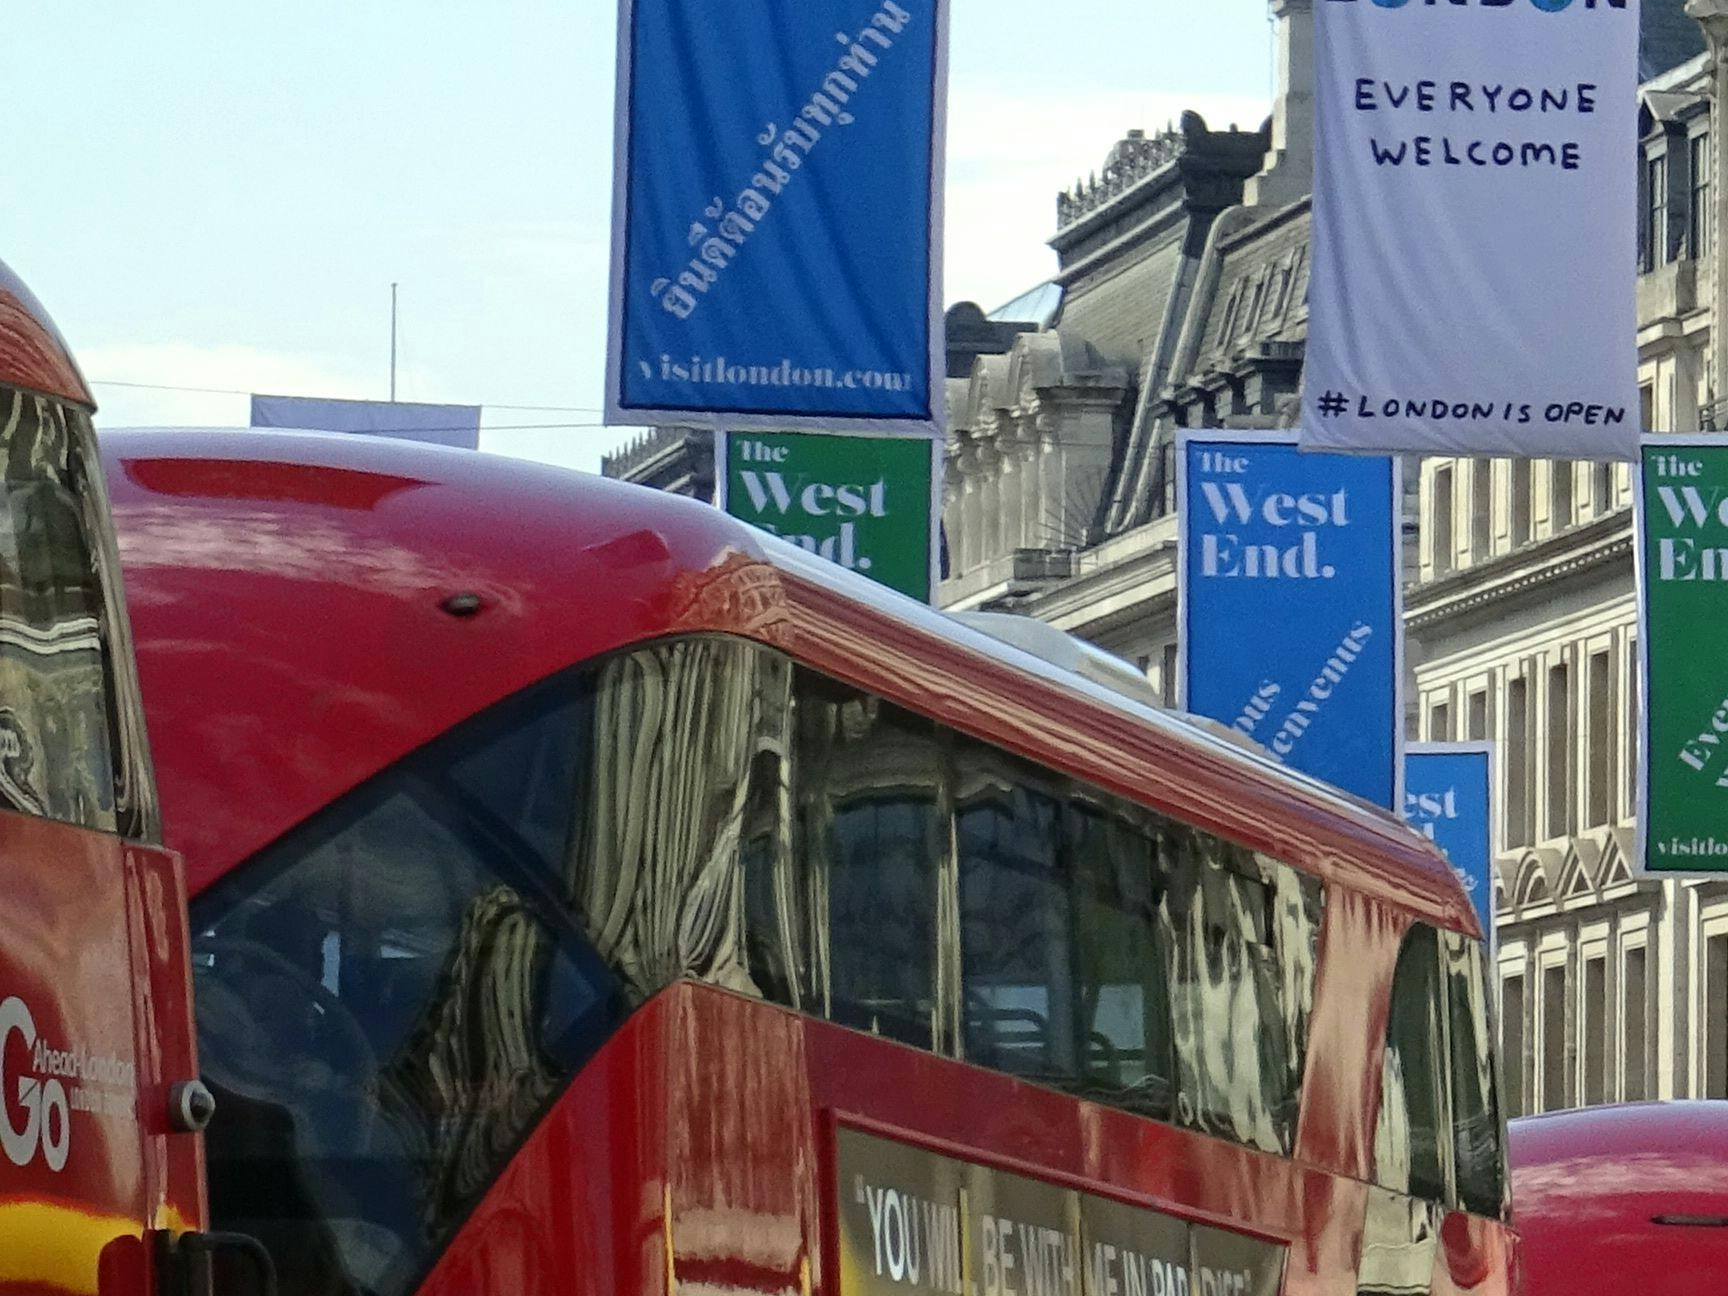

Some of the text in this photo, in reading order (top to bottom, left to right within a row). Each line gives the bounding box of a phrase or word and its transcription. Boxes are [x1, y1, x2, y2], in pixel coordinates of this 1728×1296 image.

[1354, 79, 1598, 113] EVERYONE
[1370, 137, 1581, 169] WELCOME
[640, 354, 912, 392] visitlondon.com
[737, 440, 789, 462] The
[1200, 451, 1250, 474] The
[1651, 455, 1703, 477] The
[740, 471, 889, 518] West
[1201, 482, 1351, 528] West
[752, 522, 872, 569] nd.
[1200, 532, 1336, 578] End.
[1234, 679, 1281, 731] ous
[1265, 621, 1373, 761] envenus
[1403, 785, 1459, 819] est
